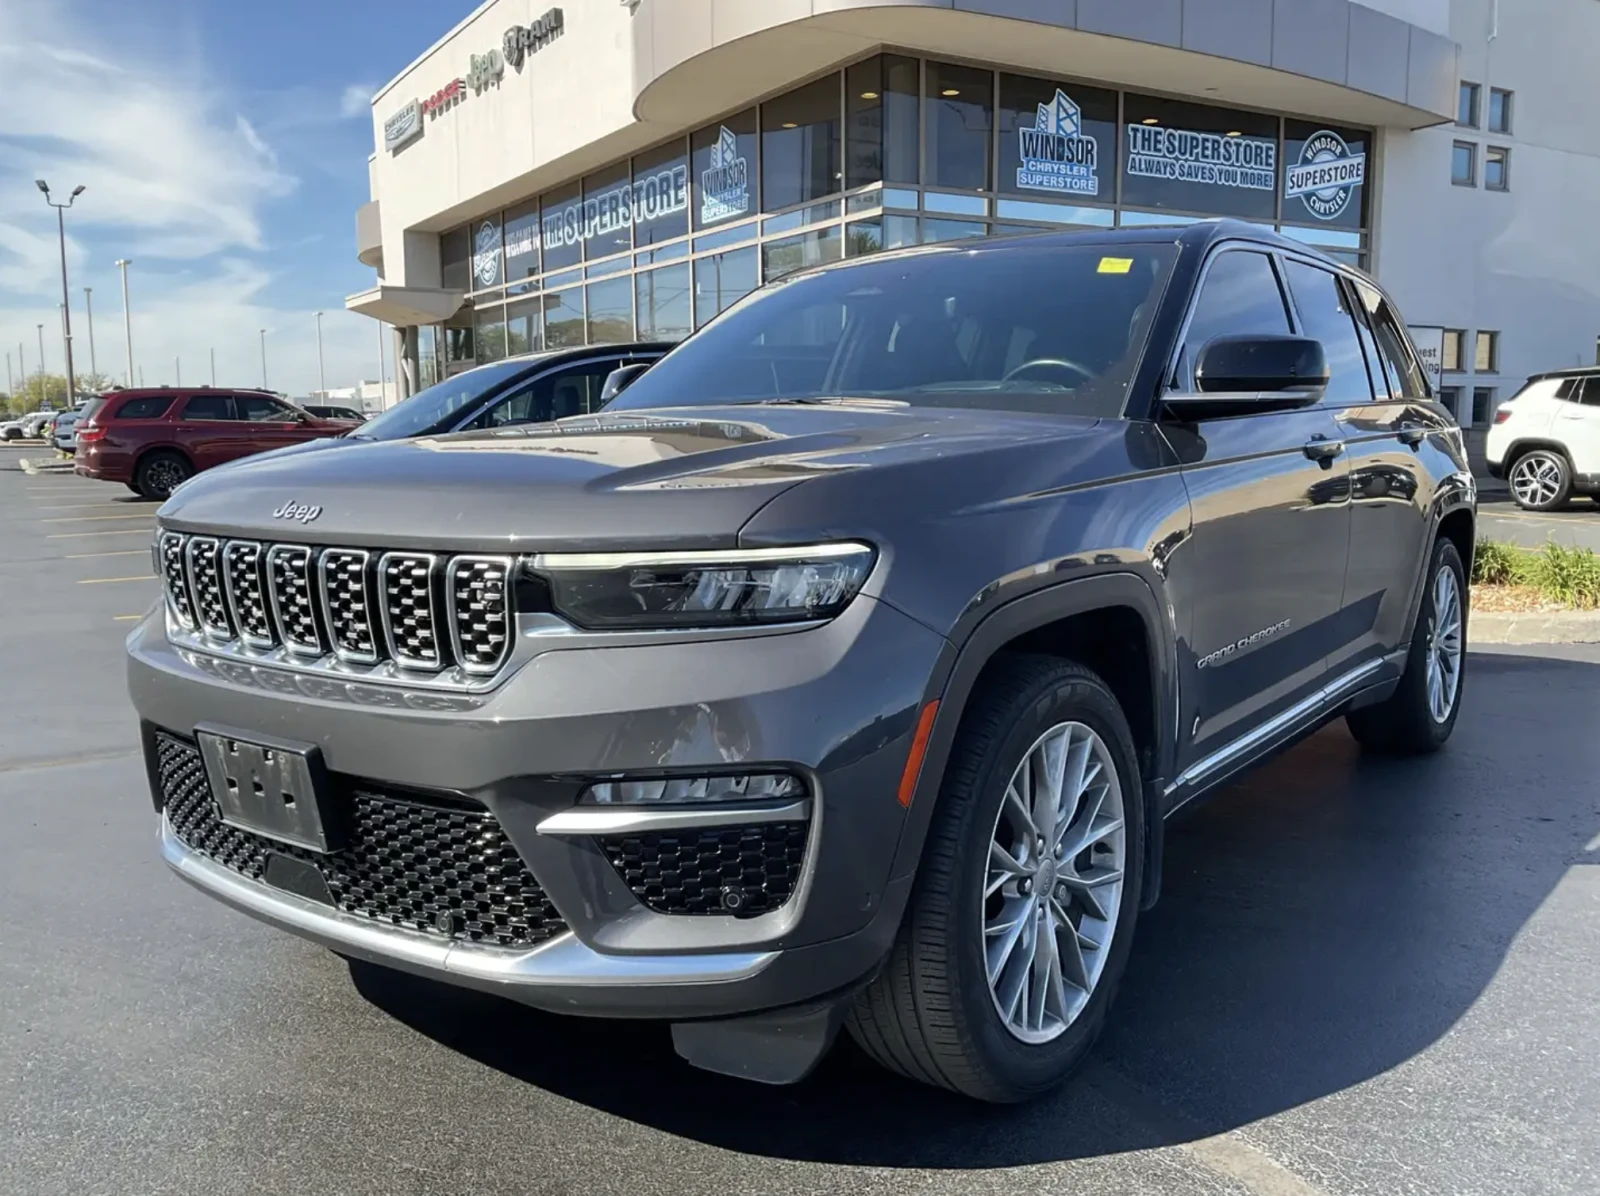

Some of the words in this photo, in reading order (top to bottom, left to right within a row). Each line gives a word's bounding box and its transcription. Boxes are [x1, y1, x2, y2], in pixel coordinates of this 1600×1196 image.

[519, 8, 560, 48] RAM
[384, 104, 416, 132] CHRYSLER
[1022, 131, 1094, 166] WINDSOR
[1130, 126, 1163, 154] THE
[1166, 130, 1274, 168] SUPERSTORE
[1305, 137, 1342, 160] WINDSOR
[704, 161, 746, 196] WINDSOR
[1020, 173, 1095, 190] SUPERSTORE
[1028, 161, 1087, 176] CHRYSLER
[1129, 157, 1176, 178] ALWAYS
[1178, 162, 1215, 181] SAVES
[1215, 167, 1238, 186] YOU
[1240, 171, 1274, 188] MORE!
[1289, 162, 1362, 190] SUPERSTORE
[565, 166, 686, 244] SUPERSTORE
[1310, 189, 1347, 214] CHRYSLER
[272, 499, 323, 525] Jeep
[1196, 643, 1235, 669] GRAND
[1237, 618, 1291, 649] CHEROKEE
